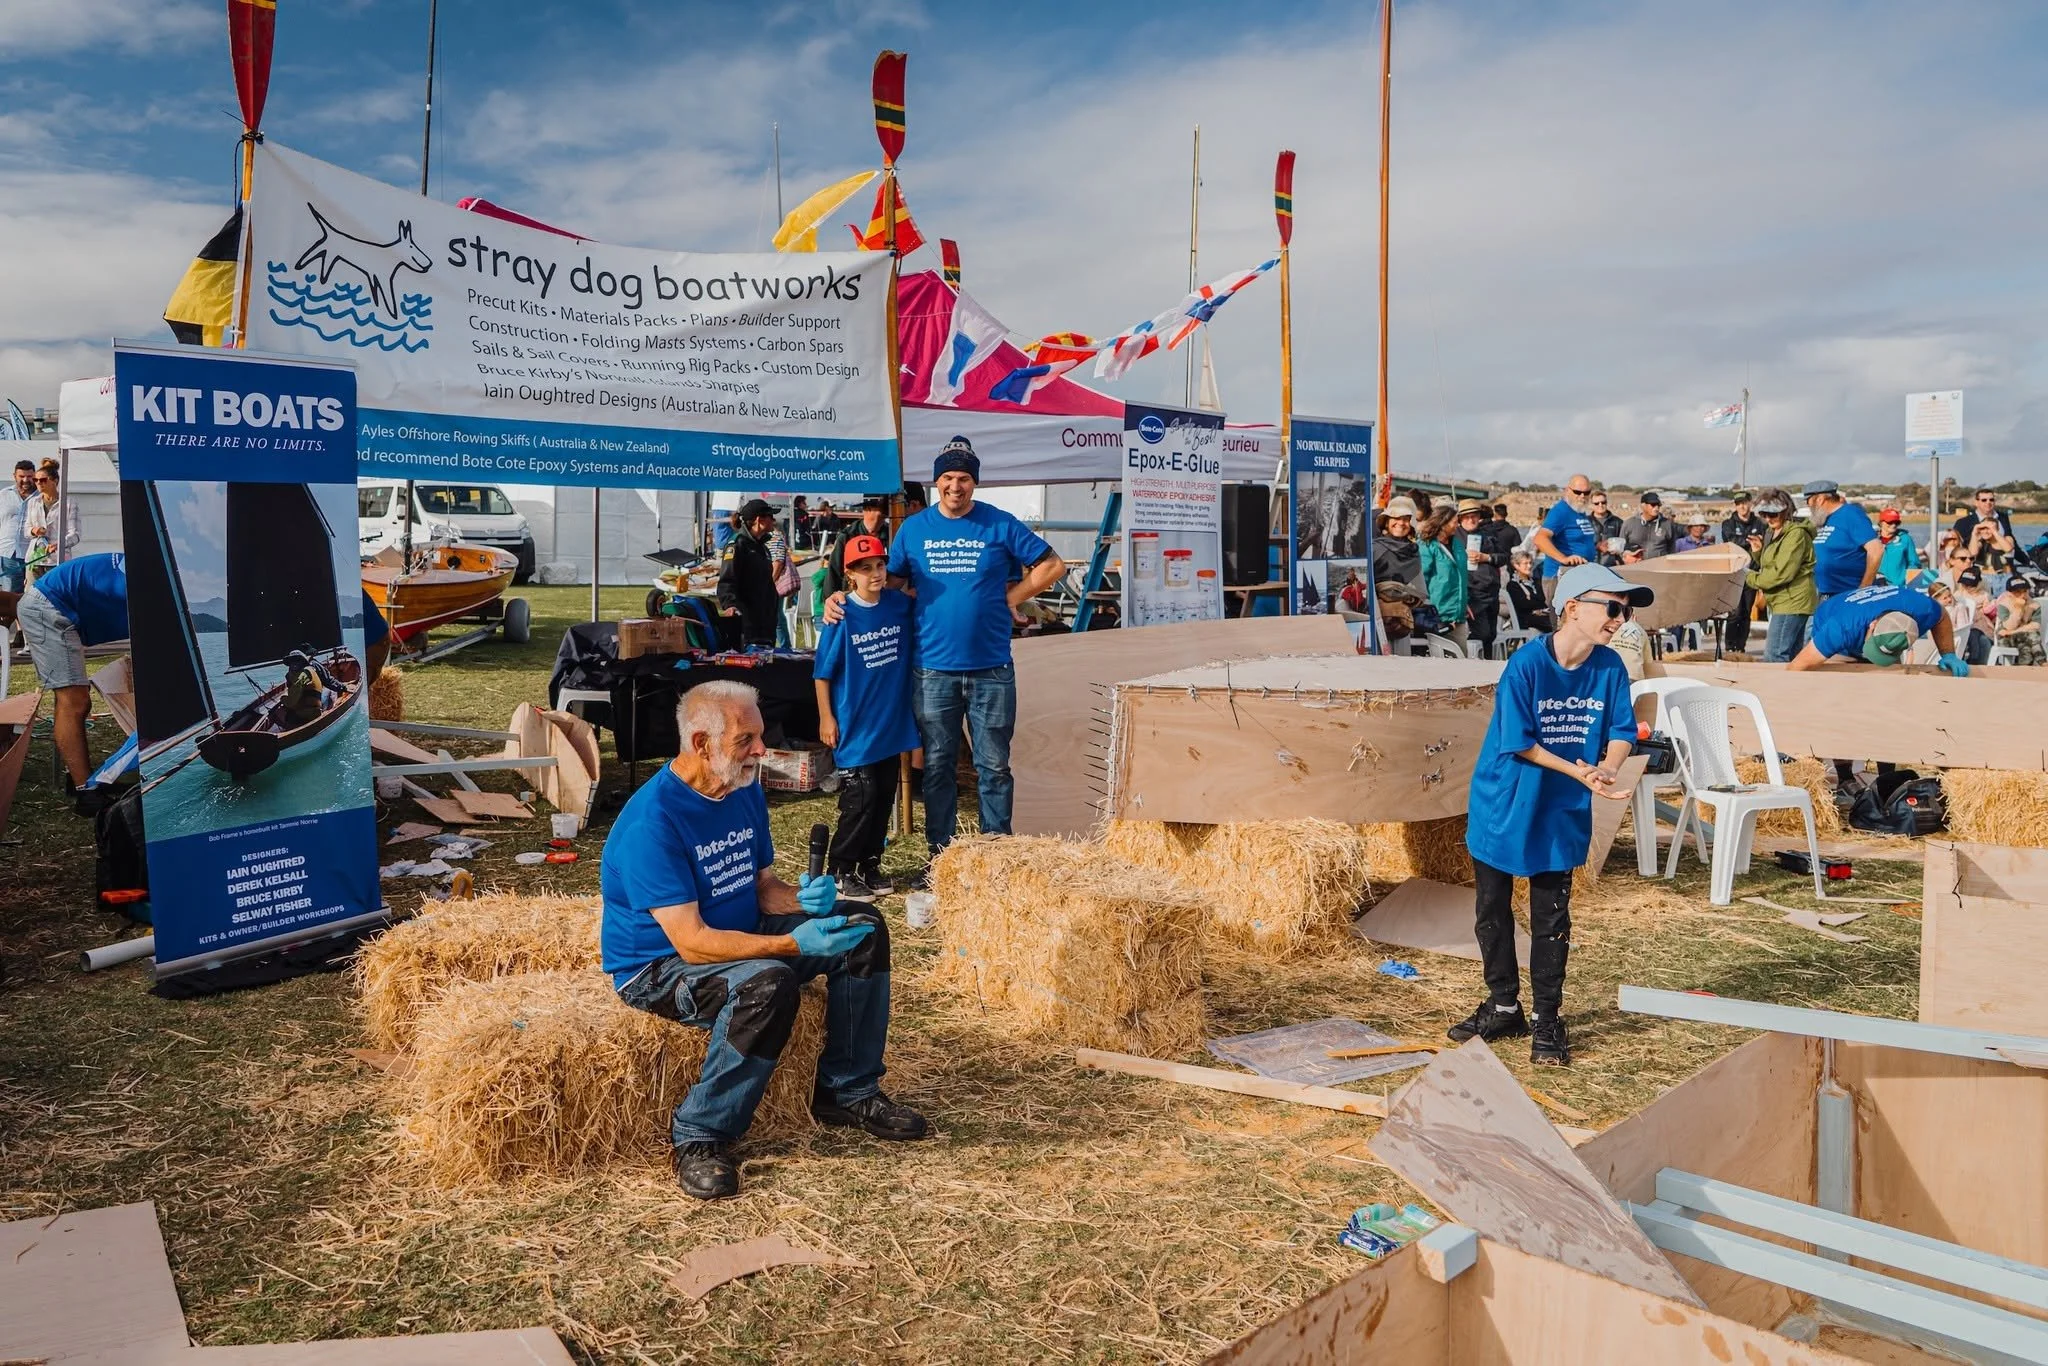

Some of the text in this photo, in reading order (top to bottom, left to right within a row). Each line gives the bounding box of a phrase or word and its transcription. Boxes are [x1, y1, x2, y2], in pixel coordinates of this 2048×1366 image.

[447, 235, 861, 309] stray dog boatworks
[467, 288, 841, 331] Precut Kits Materials Packs Plans Builder Support
[469, 315, 844, 356] Construction Folding Masts Systems Carbon Spars
[472, 339, 860, 380] Sails & Sail Covers Running Rig Packs Custom Design
[477, 362, 526, 377] Bruce
[528, 366, 582, 383] Kirby's
[703, 379, 760, 396] Sharpies
[132, 384, 203, 425] KIT
[213, 390, 345, 431] BOATS
[484, 383, 838, 423] Iain Oughtred Designs (Australian & New Zealand)
[155, 433, 327, 452] THERE ARE NO LIMITS.
[361, 423, 395, 440] Ayles
[398, 426, 450, 442] Offshore
[453, 430, 498, 448] Rowing
[501, 433, 531, 447] Skiffs
[540, 435, 587, 450] Australia
[590, 438, 598, 450] &
[600, 439, 624, 452] New
[626, 440, 670, 456] Zealand)
[711, 441, 865, 462] straydogboatworks.com
[1062, 427, 1260, 453] Comm eurieu
[1296, 440, 1367, 454] NORWALK ISLANDS
[374, 450, 459, 467] recommend
[462, 453, 493, 469] Bote
[496, 456, 526, 470] Cote
[529, 457, 568, 474] Epoxy
[570, 459, 619, 475] Systems
[621, 463, 644, 475] and
[647, 465, 700, 478] Aquacote
[702, 465, 734, 478] Water
[736, 466, 767, 479] Based
[769, 468, 836, 483] Polyurethane
[838, 469, 869, 481] Paints
[1128, 447, 1220, 475] Epox-E-Glue
[1314, 455, 1350, 468] SHARPIES
[857, 539, 870, 552] C
[924, 538, 985, 550] Bote-Cote
[929, 558, 977, 566] Boatbuilding
[851, 625, 901, 645] Bote-Cote
[1540, 714, 1556, 724] ugh
[1567, 714, 1596, 724] Ready
[1541, 725, 1589, 734] atbuilding
[243, 826, 271, 836] homebuilt
[695, 827, 754, 861] Bote-Cote
[227, 855, 306, 880] IAIN OUGHTRED
[241, 847, 289, 862] DESIGNERS:
[228, 869, 309, 895] DEREK KELSALL
[711, 874, 754, 897] Competition
[236, 884, 304, 908] BRUCE KIRBY
[232, 897, 312, 924] SELWAY FISHER
[199, 904, 345, 945] KITS & OWNER/BUILDER WORKSHOPS
